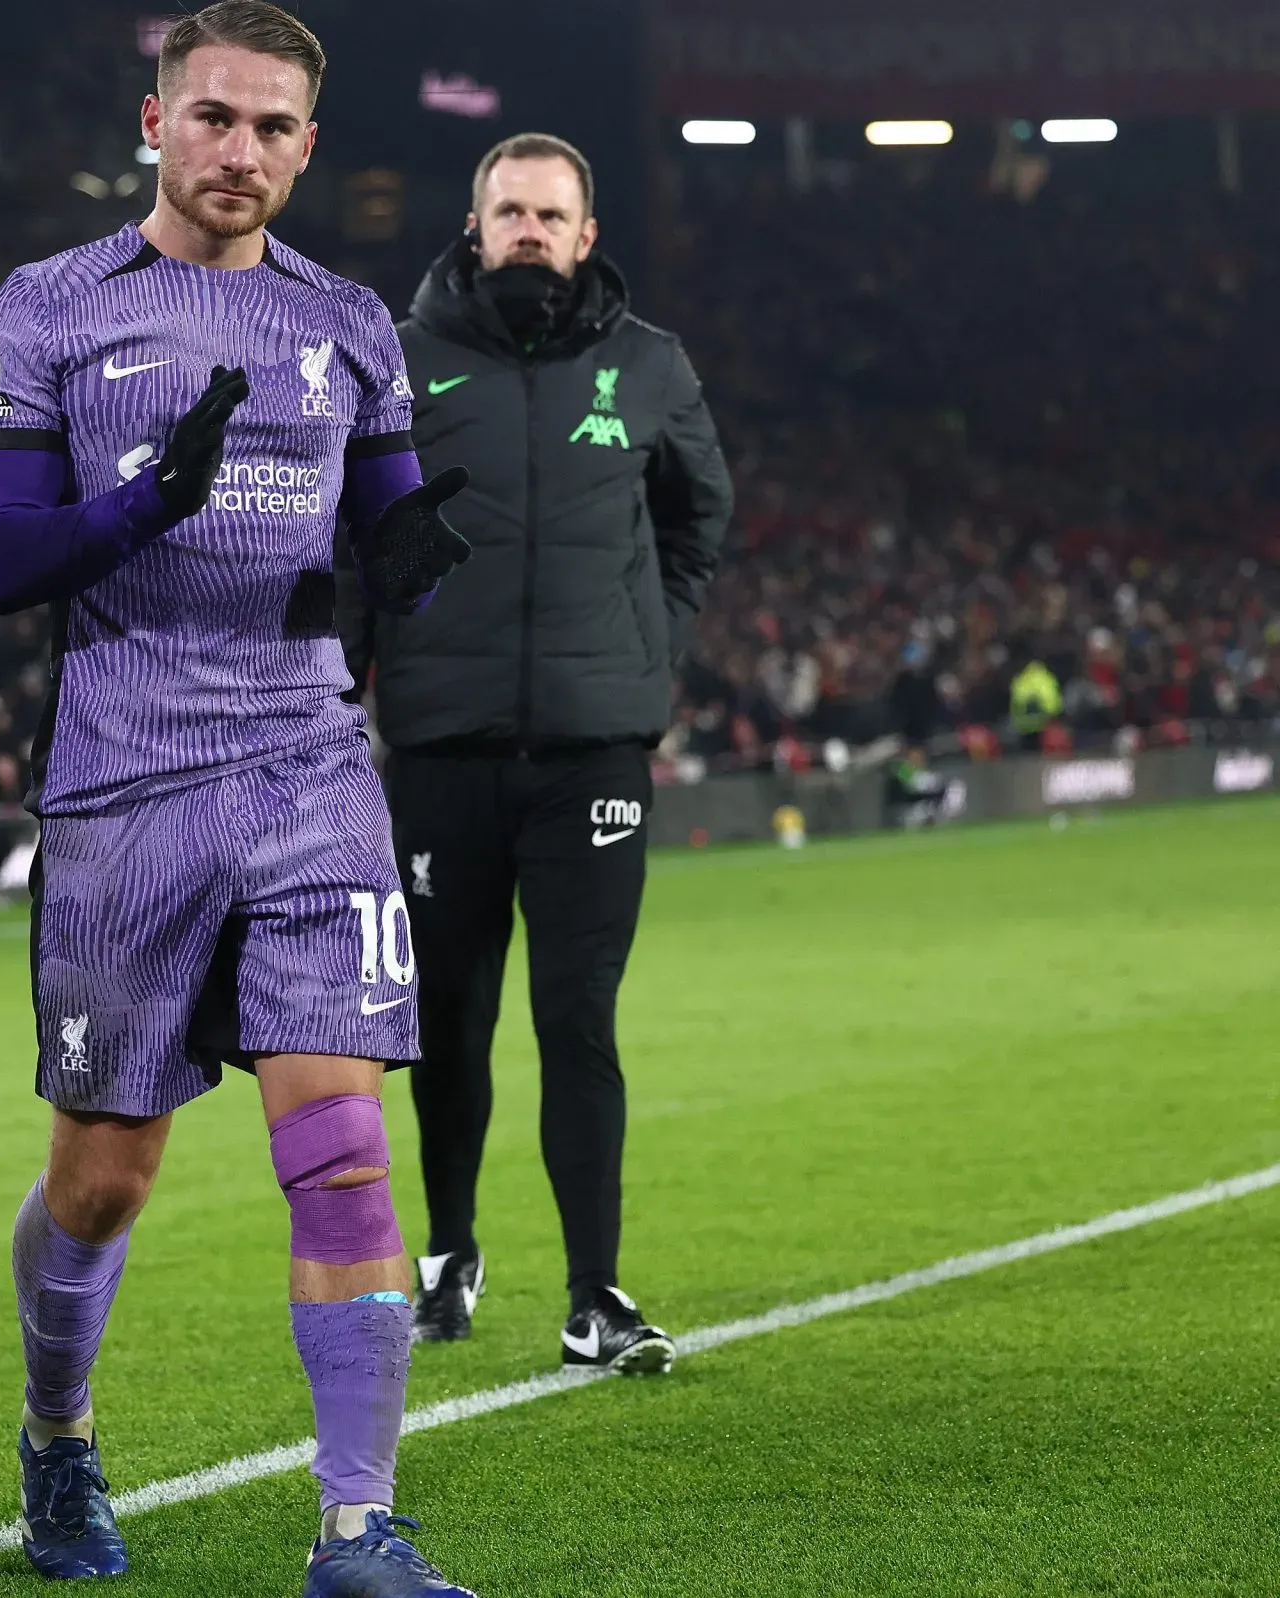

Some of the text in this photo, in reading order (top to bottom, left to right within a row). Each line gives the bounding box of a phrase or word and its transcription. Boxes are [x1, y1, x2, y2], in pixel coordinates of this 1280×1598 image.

[568, 413, 629, 449] AXA
[214, 460, 323, 488] andard
[201, 486, 320, 514] hartered
[590, 798, 642, 827] CMO
[349, 890, 415, 986] 10
